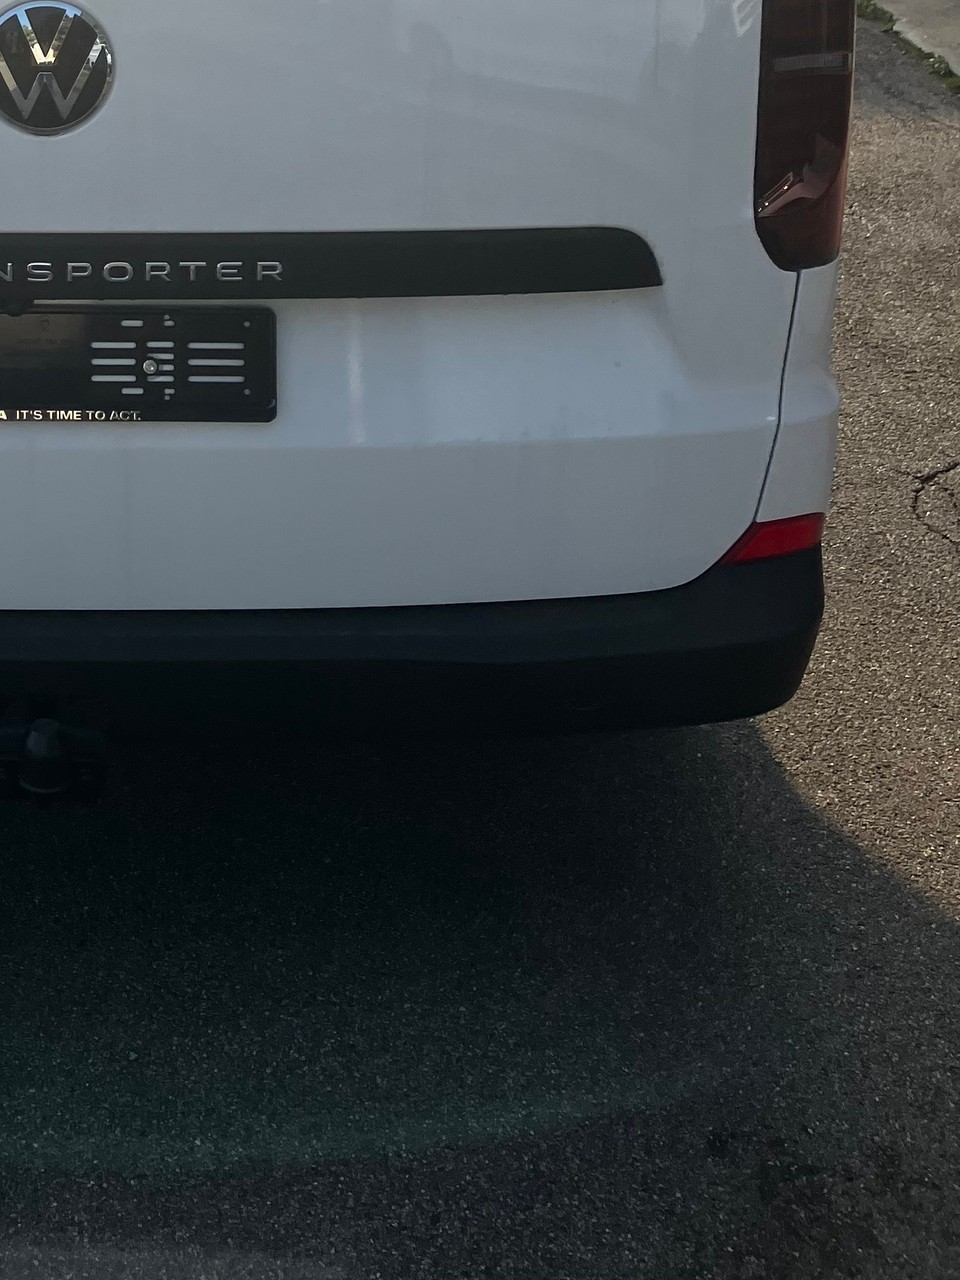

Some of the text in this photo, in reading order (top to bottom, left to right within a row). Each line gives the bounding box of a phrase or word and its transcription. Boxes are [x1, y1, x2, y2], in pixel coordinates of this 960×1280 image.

[16, 409, 43, 421] IT'S
[46, 409, 82, 421] TIME
[86, 409, 106, 421] TO
[109, 409, 141, 421] ACT.
